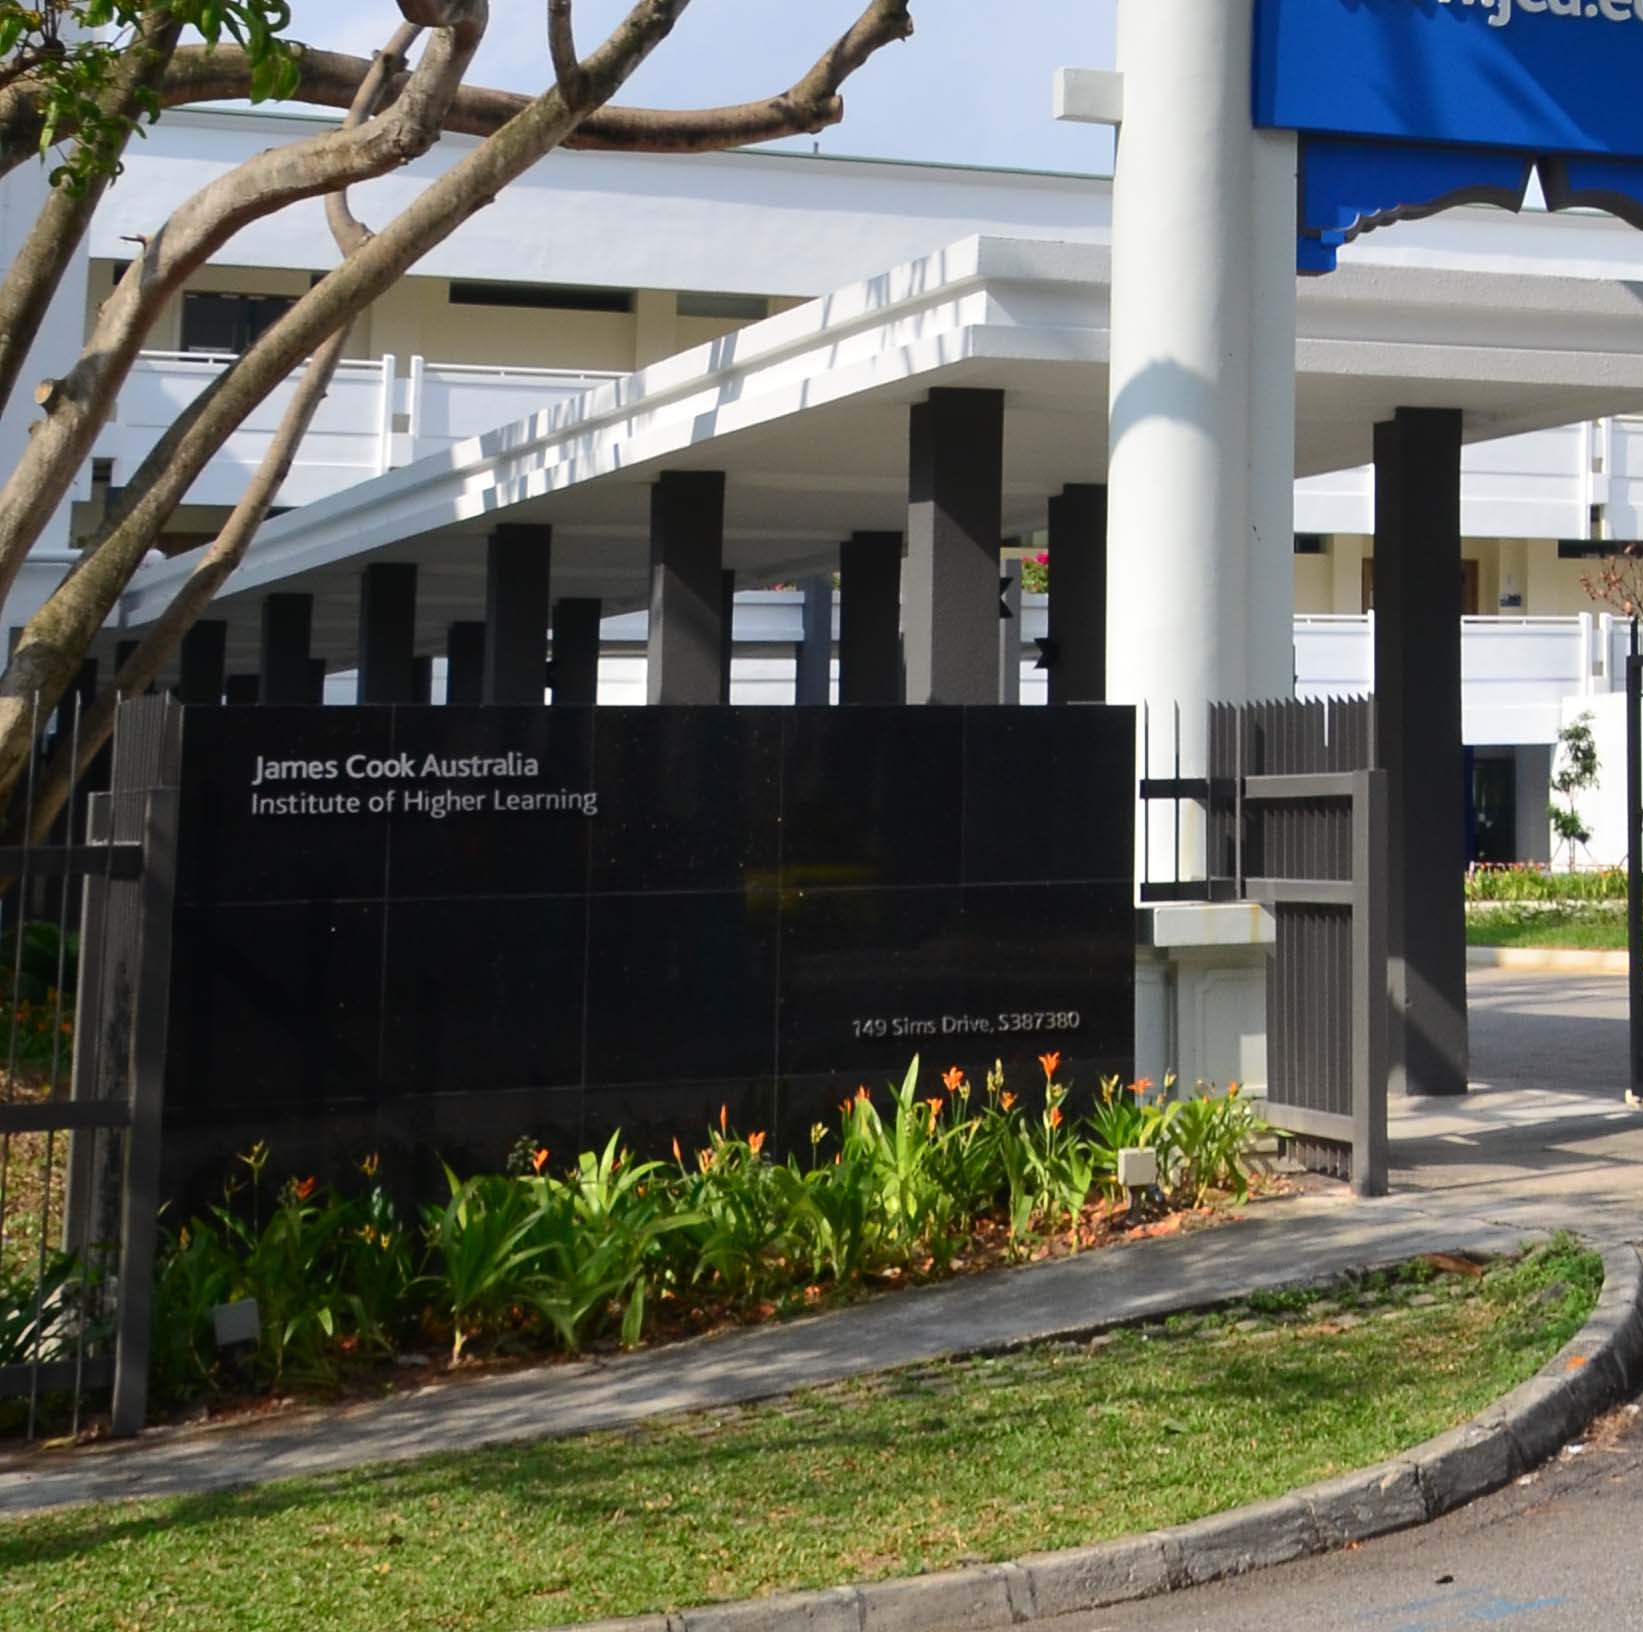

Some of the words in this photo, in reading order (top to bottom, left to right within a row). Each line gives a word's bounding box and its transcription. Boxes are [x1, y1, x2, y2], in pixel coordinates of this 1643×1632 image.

[252, 755, 338, 786] James
[345, 753, 416, 779] Cook
[420, 752, 539, 777] Australia
[251, 791, 361, 816] Institute
[368, 789, 397, 813] of
[404, 789, 485, 818] Higher
[494, 788, 599, 816] Learning
[852, 1019, 887, 1038] 149
[892, 1016, 937, 1036] Sims
[942, 1014, 994, 1034] Drive,
[998, 1011, 1081, 1032] S387380
